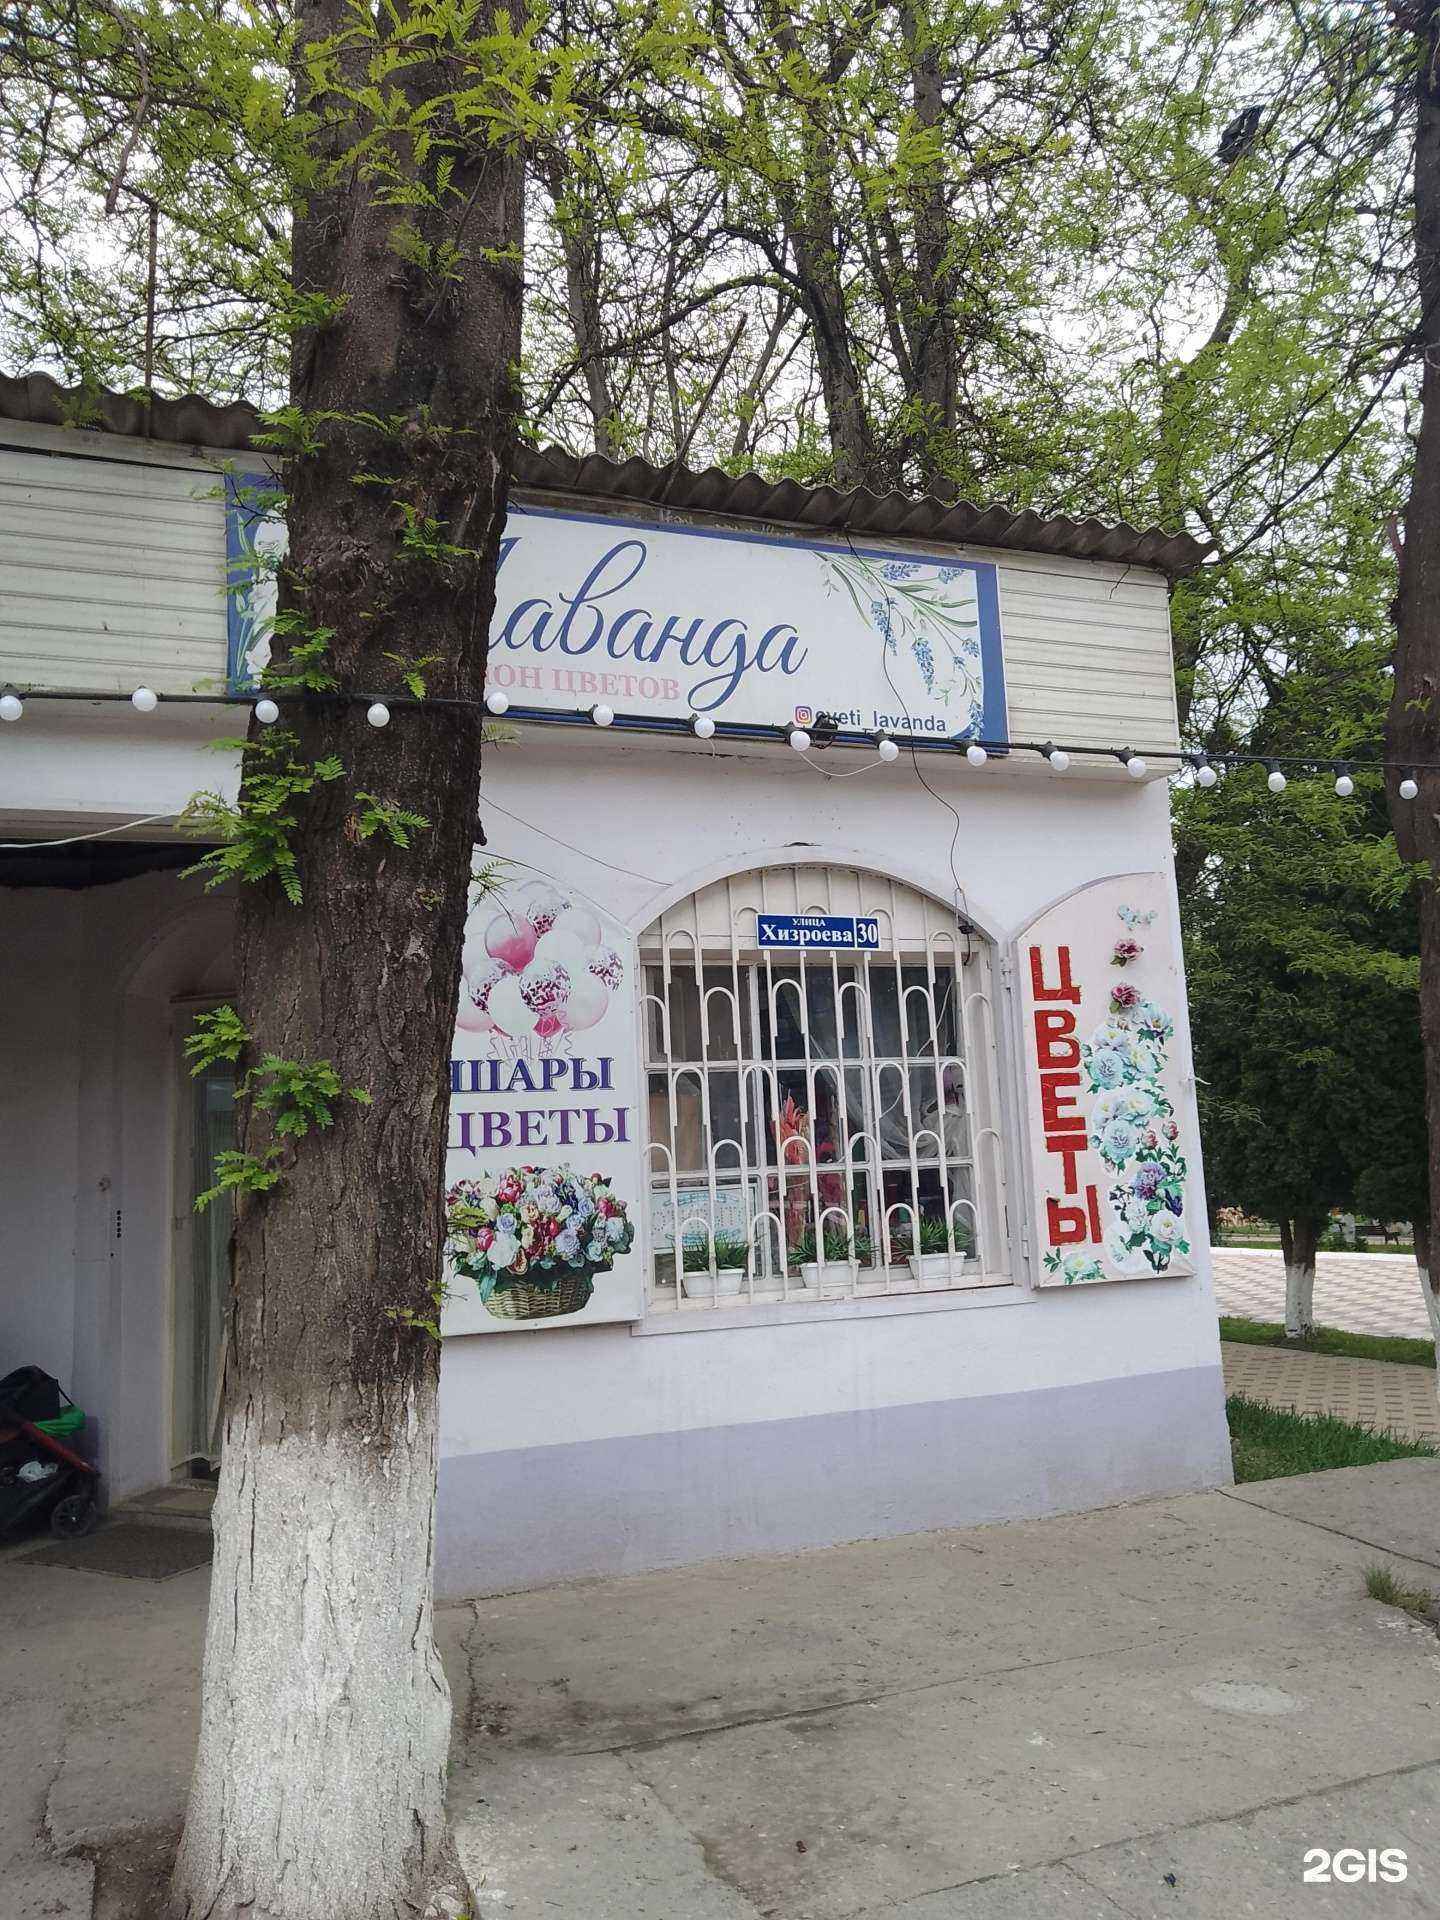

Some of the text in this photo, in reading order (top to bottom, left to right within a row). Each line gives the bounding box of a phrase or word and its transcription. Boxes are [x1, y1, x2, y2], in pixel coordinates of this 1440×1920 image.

[486, 664, 681, 701] ОН ЦВЕТОВ
[760, 923, 878, 946] Хизроева 30
[792, 917, 826, 927] УЛИЦА
[450, 1056, 616, 1093] ШАРЫ
[1028, 945, 1103, 1247] ЦВЕТЫ
